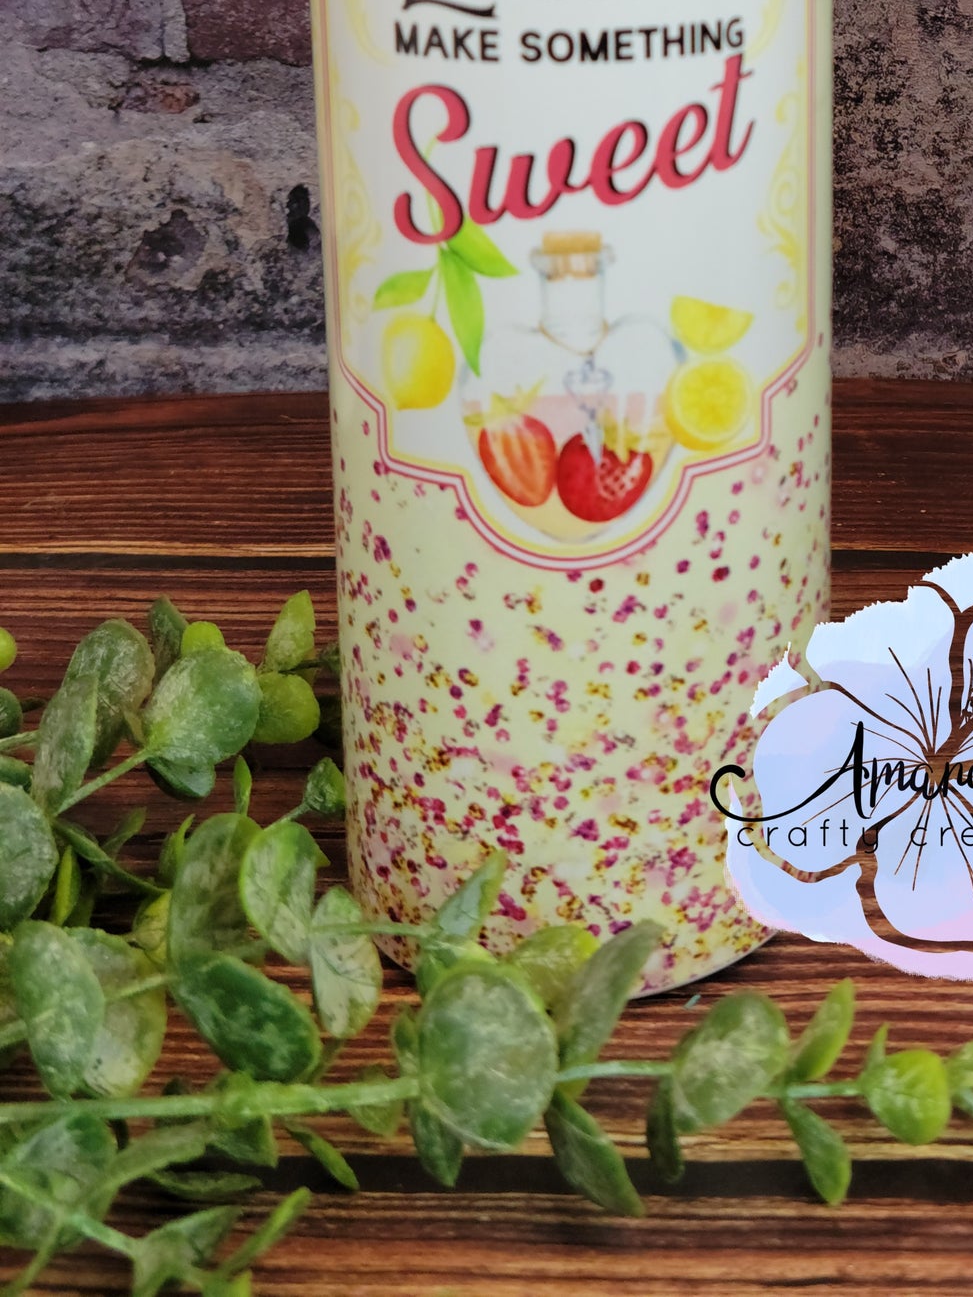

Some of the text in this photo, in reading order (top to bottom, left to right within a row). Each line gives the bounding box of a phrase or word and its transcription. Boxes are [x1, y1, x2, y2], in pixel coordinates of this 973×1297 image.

[394, 17, 745, 63] MAKE SOMETHING
[392, 53, 755, 245] Sweet
